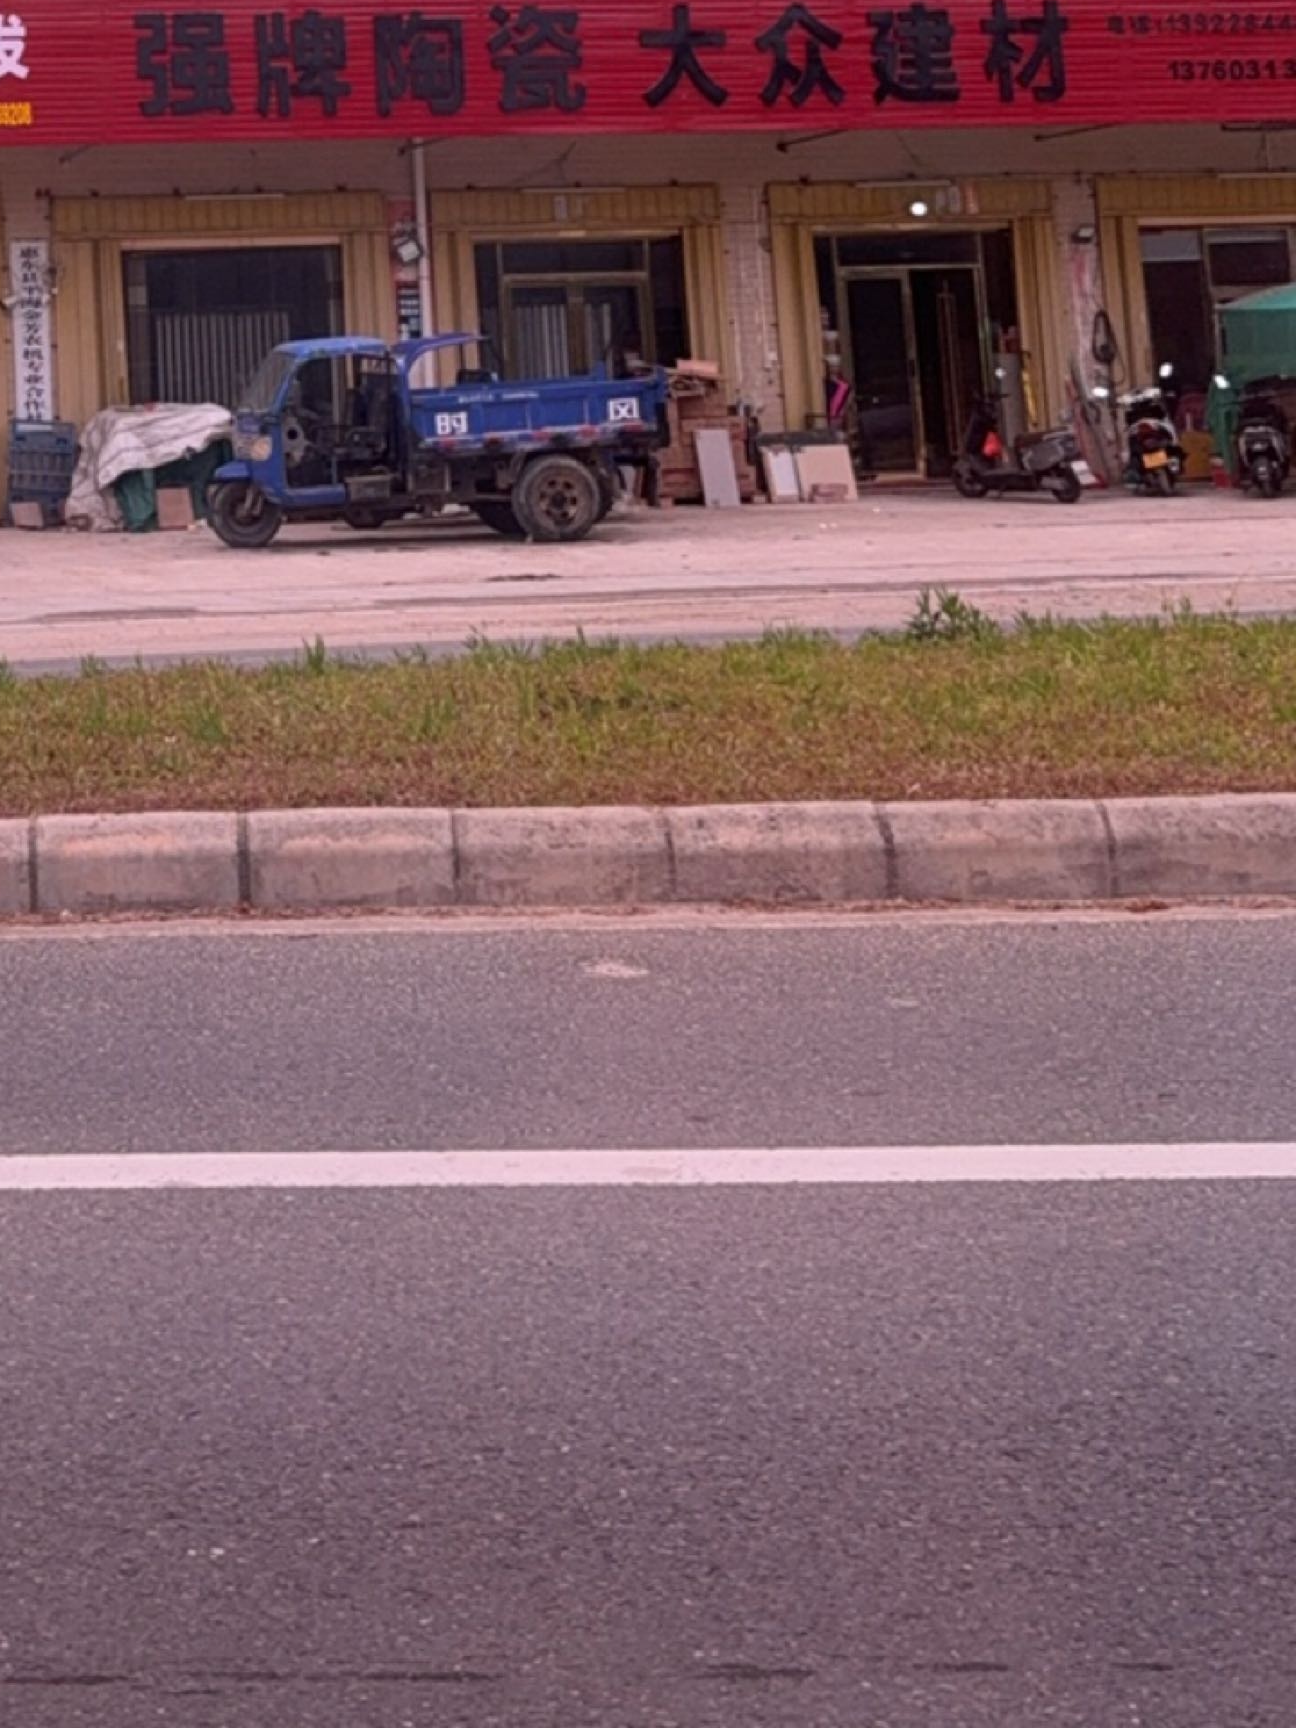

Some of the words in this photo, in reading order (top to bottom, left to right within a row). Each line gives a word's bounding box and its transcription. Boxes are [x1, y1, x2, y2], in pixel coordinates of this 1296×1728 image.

[134, 4, 588, 119] 强牌陶瓷
[638, 0, 1068, 108] 大众建材
